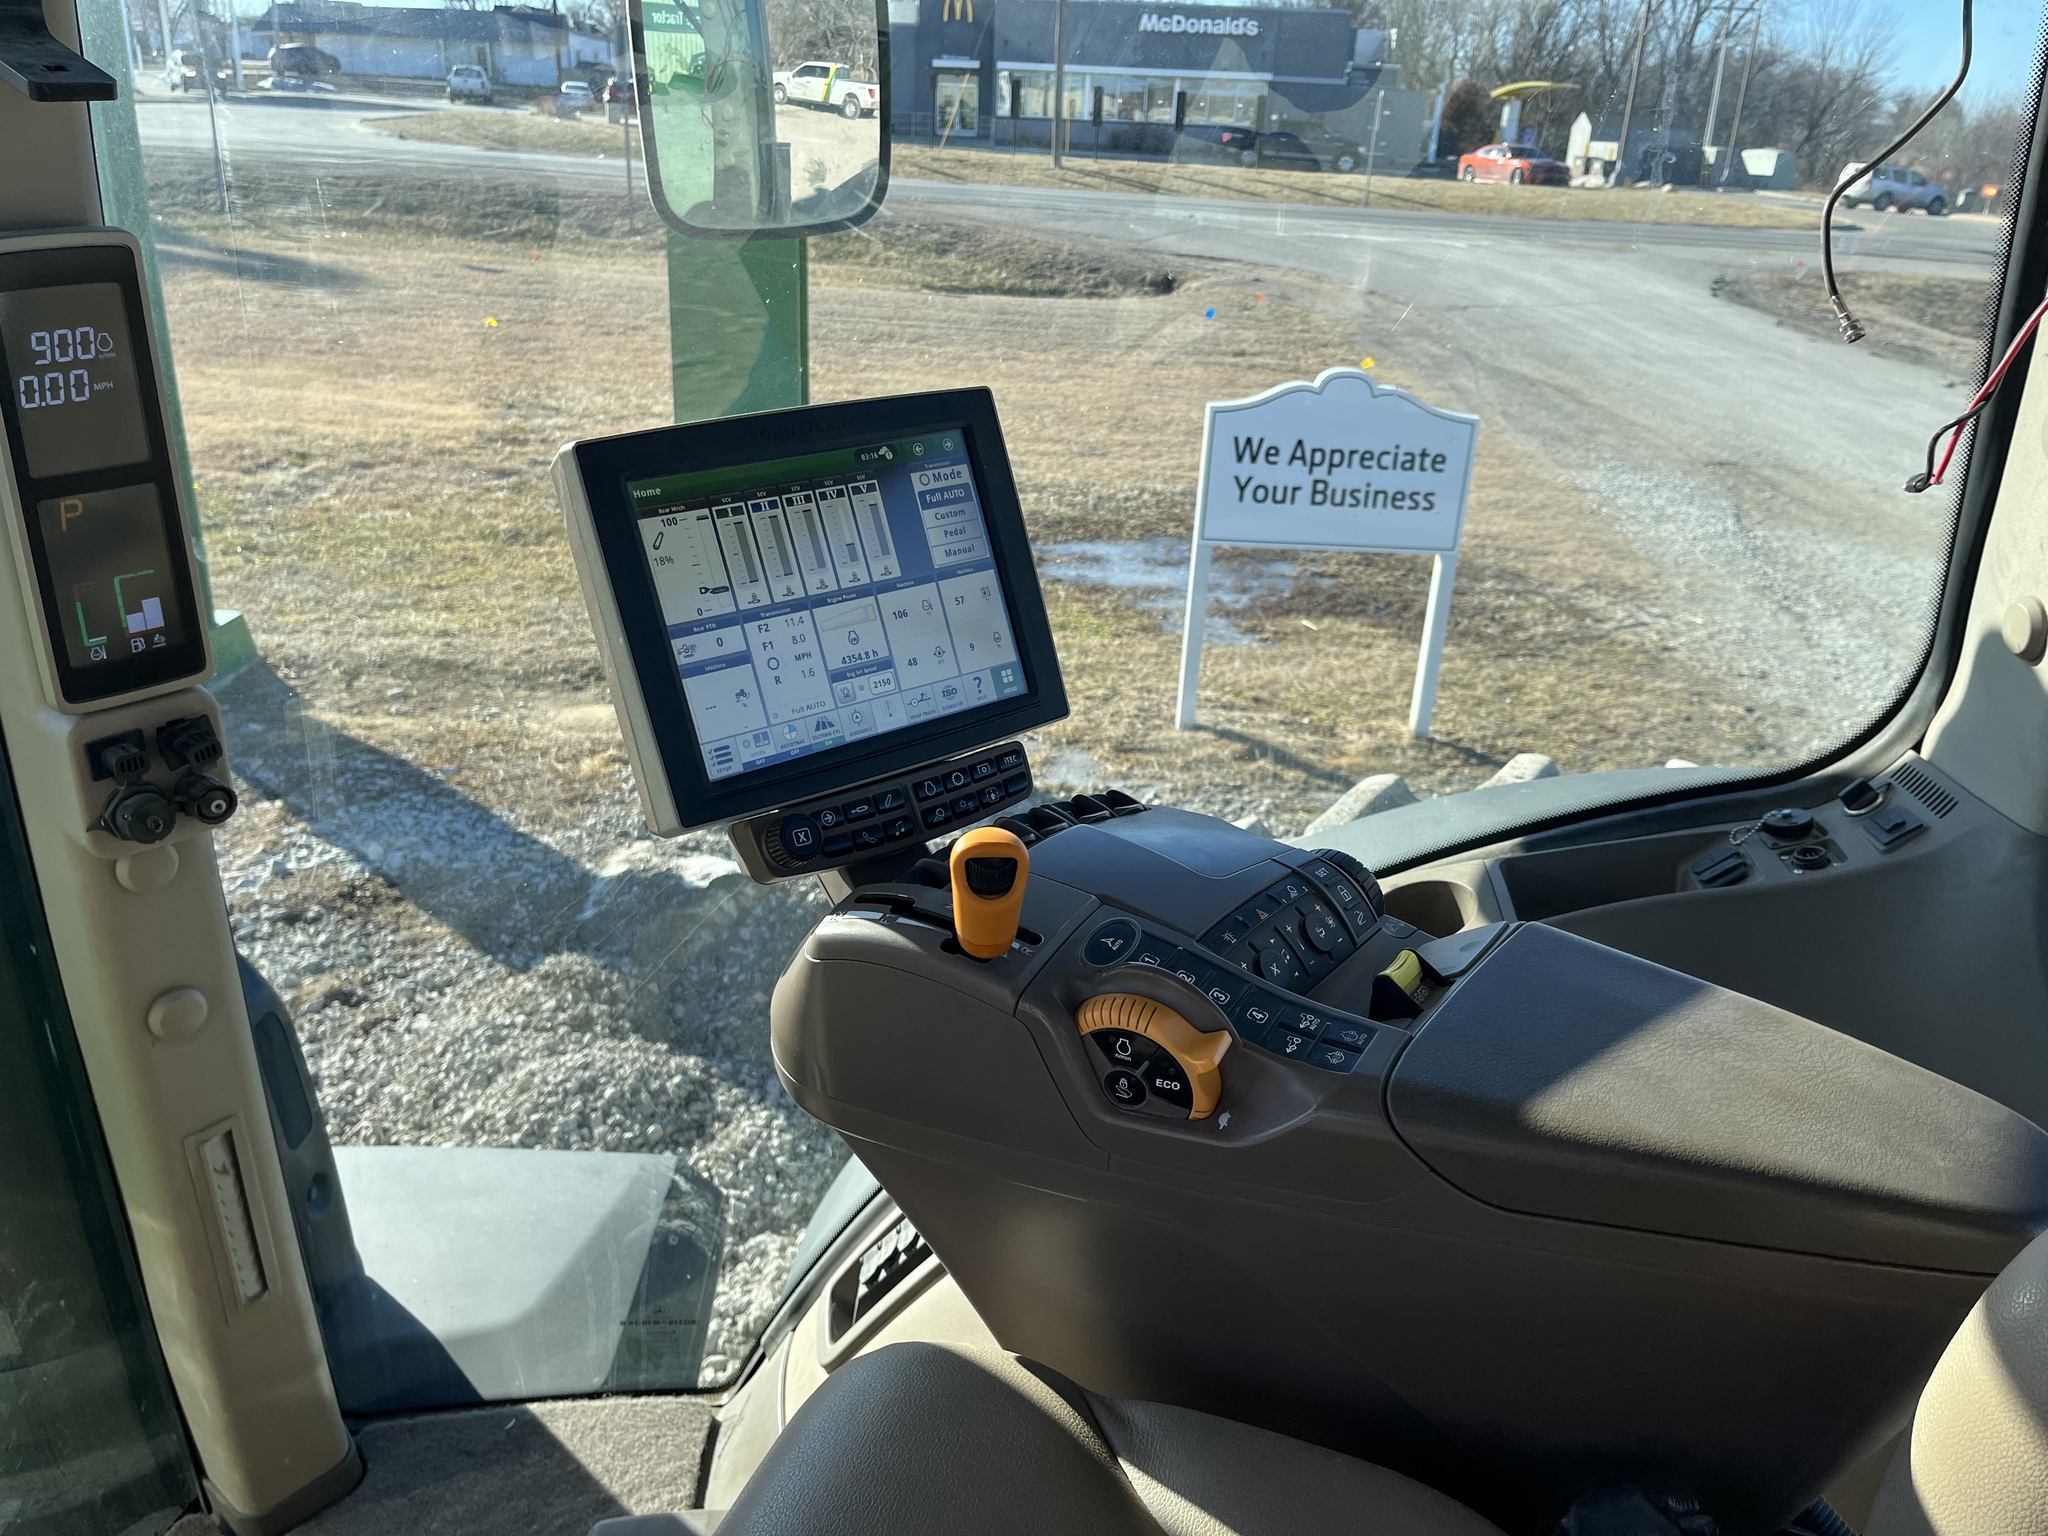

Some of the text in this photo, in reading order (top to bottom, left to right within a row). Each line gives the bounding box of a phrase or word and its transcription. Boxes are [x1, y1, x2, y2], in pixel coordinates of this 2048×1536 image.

[1139, 13, 1259, 36] McDonald's
[31, 327, 96, 365] 900
[19, 369, 90, 409] 0.00
[93, 381, 114, 391] MPH
[861, 452, 879, 461] 03:16
[1233, 436, 1447, 476] We Appreciate
[932, 469, 963, 483] Mode
[633, 486, 662, 499] Home
[826, 490, 838, 499] IV
[859, 484, 868, 494] V
[1233, 475, 1436, 511] Your Business
[792, 496, 806, 505] III
[926, 489, 965, 503] Full AUTO
[658, 504, 686, 514] Rear Hitch
[759, 502, 770, 511] II
[60, 499, 84, 532] P
[726, 508, 733, 517] I
[934, 509, 966, 521] Custom
[660, 517, 678, 528] 100
[944, 526, 967, 538] Pedal
[944, 544, 975, 558] Manual
[653, 556, 675, 567] 18%
[896, 580, 915, 589] Machine
[827, 592, 857, 604] Engine Power
[954, 596, 965, 606] 57
[697, 607, 703, 617] 0
[760, 607, 792, 618] Transmission
[892, 609, 909, 620] 106
[693, 622, 716, 633] Rear PTO
[758, 616, 805, 634] F2 11.4
[716, 637, 724, 647] 0
[762, 634, 806, 652] F1 8.0
[969, 643, 975, 652] 9
[794, 651, 812, 662] MPH
[841, 649, 879, 665] 4354.8 h
[907, 657, 918, 667] 48
[705, 662, 726, 671] Machine
[774, 668, 816, 685] R 1.6
[873, 678, 891, 689] 2150
[941, 687, 957, 697] ISO
[791, 700, 826, 715] Full AUTO
[812, 732, 831, 741] SECTION
[849, 726, 873, 737] GUIDANCE
[780, 739, 806, 749] AUTOTRAC
[716, 766, 732, 774] SETUP
[1112, 939, 1124, 951] AUTO
[1213, 991, 1226, 1001] 3
[1252, 1011, 1264, 1020] 4
[1309, 1018, 1321, 1031] AUTO
[1356, 1033, 1368, 1045] AUTO
[1156, 1079, 1180, 1090] ECO
